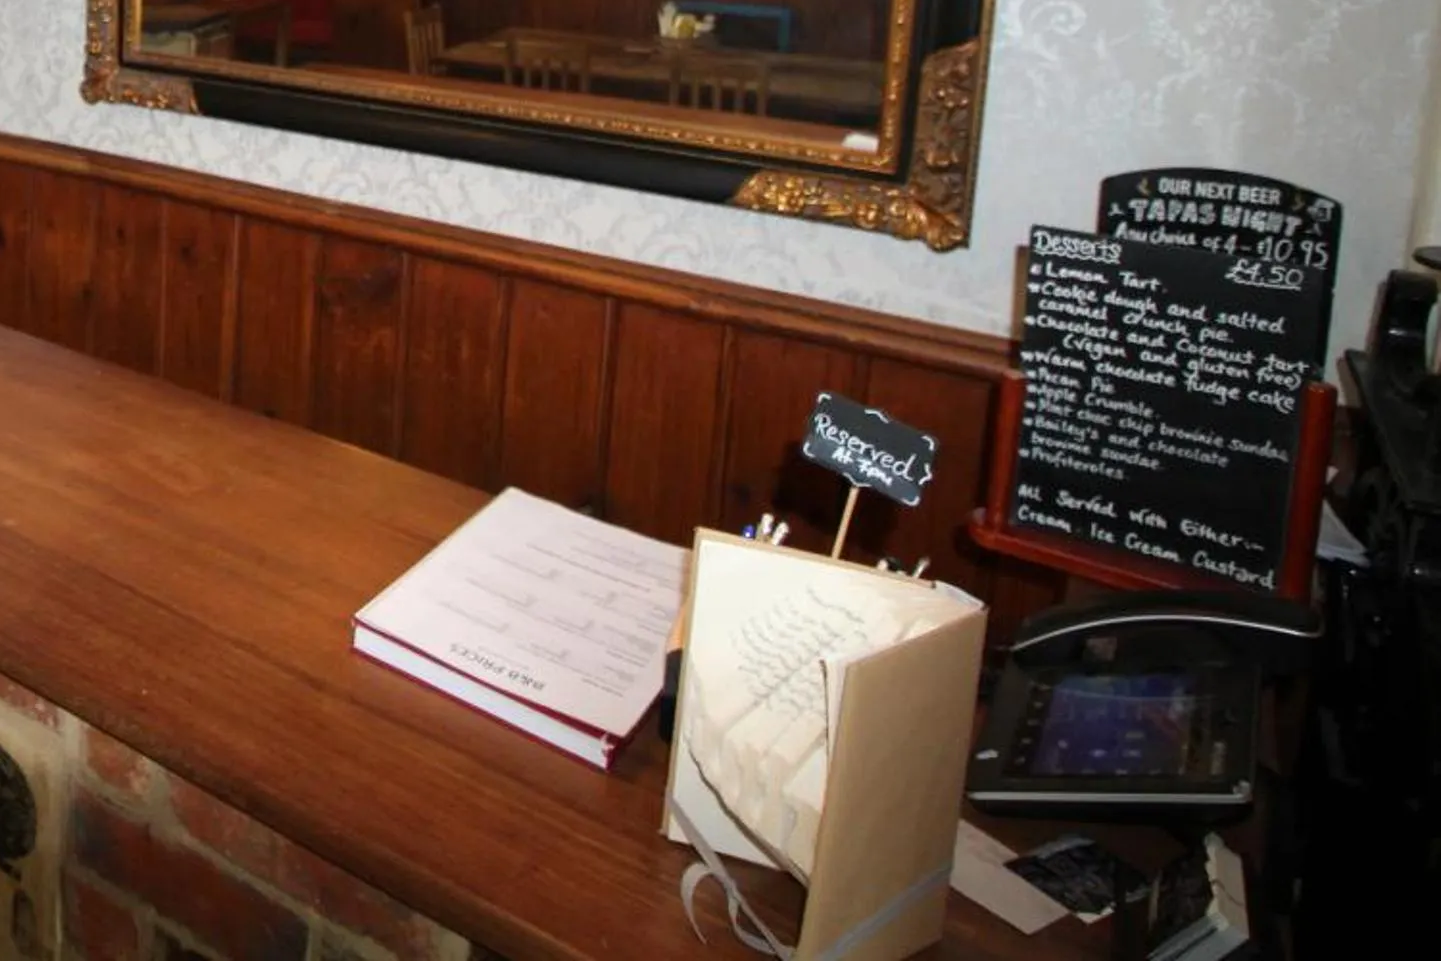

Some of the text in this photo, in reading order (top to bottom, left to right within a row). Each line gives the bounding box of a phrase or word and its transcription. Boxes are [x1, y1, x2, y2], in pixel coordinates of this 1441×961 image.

[1157, 177, 1281, 205] OUR NEXT BEER
[1129, 198, 1303, 237] TAPAS NIGHT
[1033, 230, 1122, 260] Desserts
[1202, 236, 1221, 254] of
[1045, 262, 1108, 284] Lemon
[1225, 258, 1304, 287] £4.50
[1038, 297, 1108, 321] caramel
[1041, 282, 1286, 334] Cookie dough and salted
[1126, 331, 1167, 348] and
[1175, 338, 1255, 365] Coconut
[1265, 353, 1309, 374] tart
[1140, 351, 1179, 367] and
[1187, 359, 1250, 380] gluten
[1038, 366, 1081, 389] Pecan
[1095, 361, 1177, 388] chocolate
[1184, 371, 1242, 406] fudge
[1247, 390, 1295, 415] cake
[814, 413, 917, 481] Reserved
[1108, 433, 1141, 448] and
[1148, 440, 1230, 468] chocolate
[1056, 490, 1118, 519] Served
[1090, 522, 1115, 544] Ice
[1192, 549, 1275, 591] Custard
